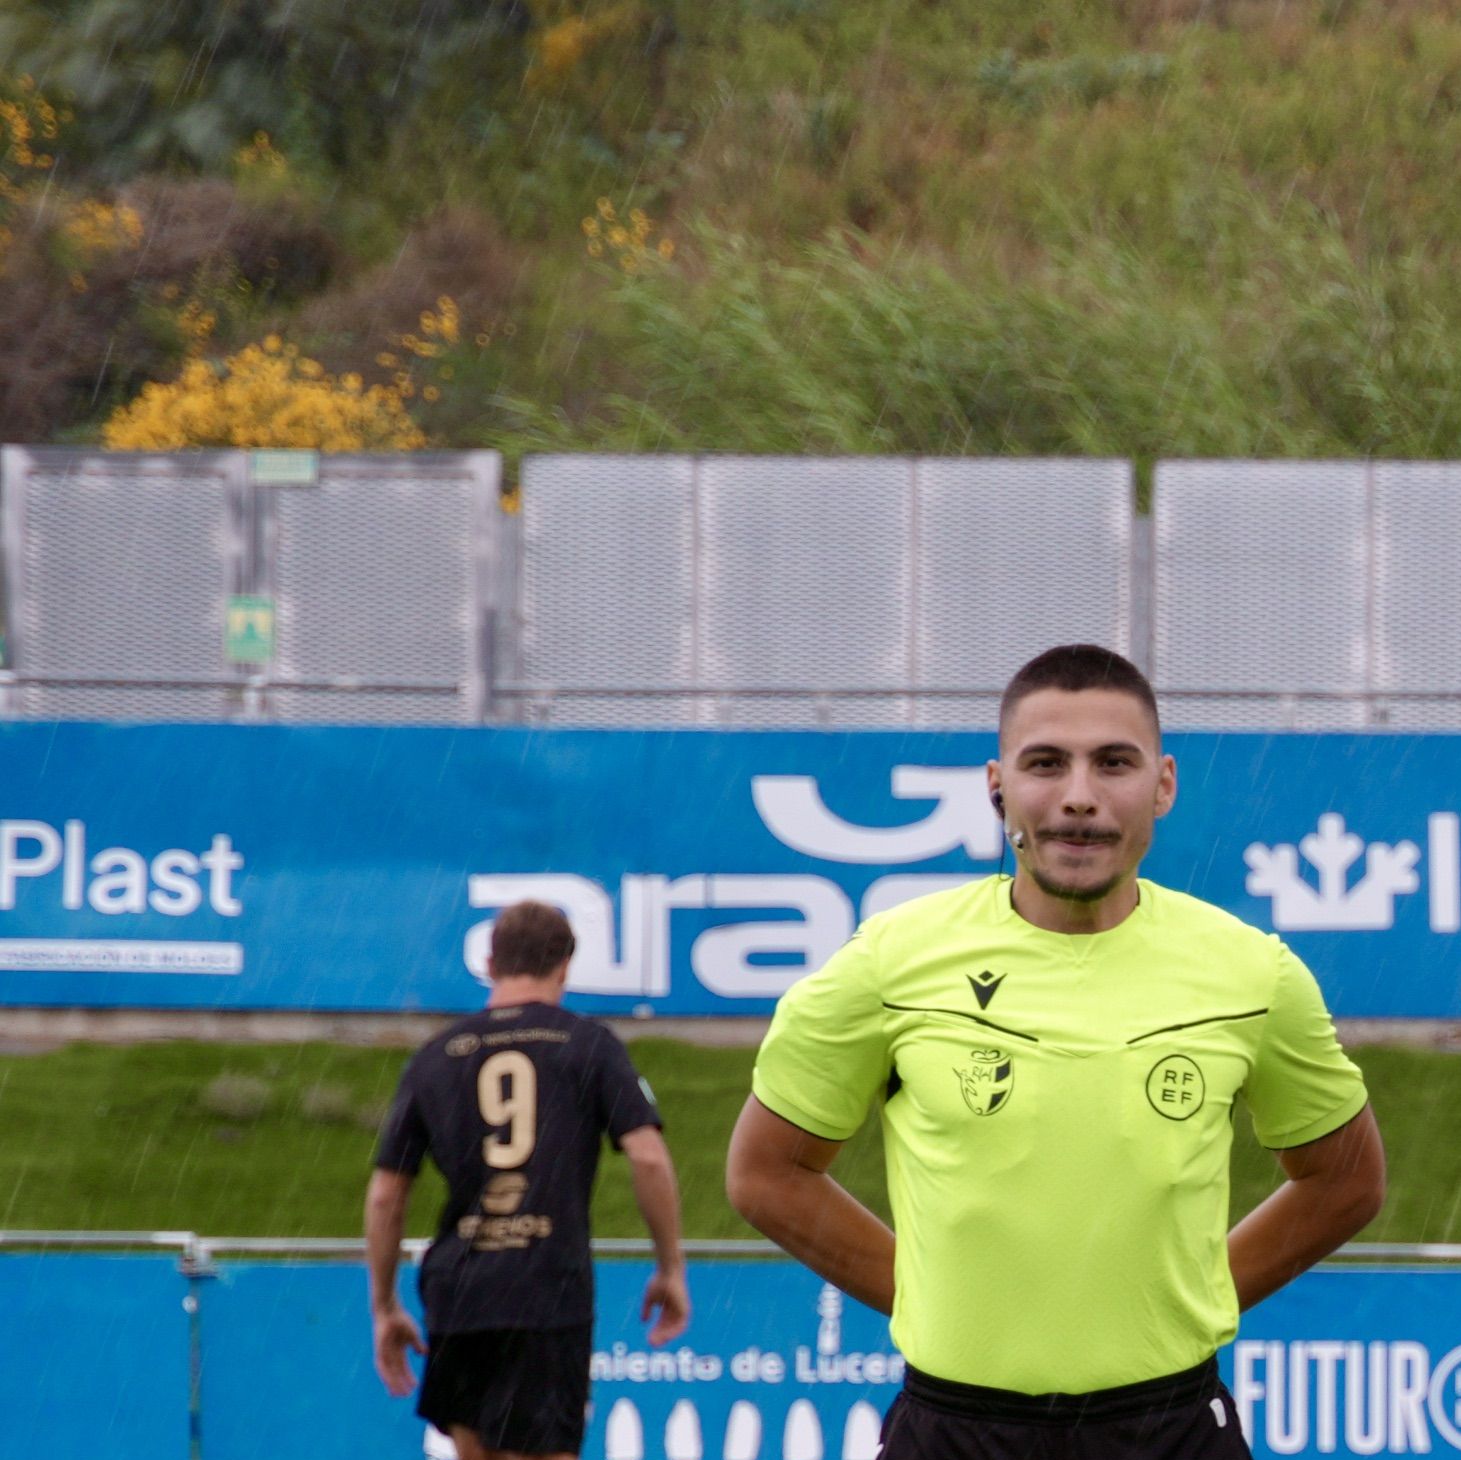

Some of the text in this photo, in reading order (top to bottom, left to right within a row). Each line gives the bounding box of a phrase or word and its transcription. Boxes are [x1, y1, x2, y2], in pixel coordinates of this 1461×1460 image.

[0, 819, 244, 917] Plast
[477, 1050, 537, 1169] 9
[731, 1346, 786, 1384] de
